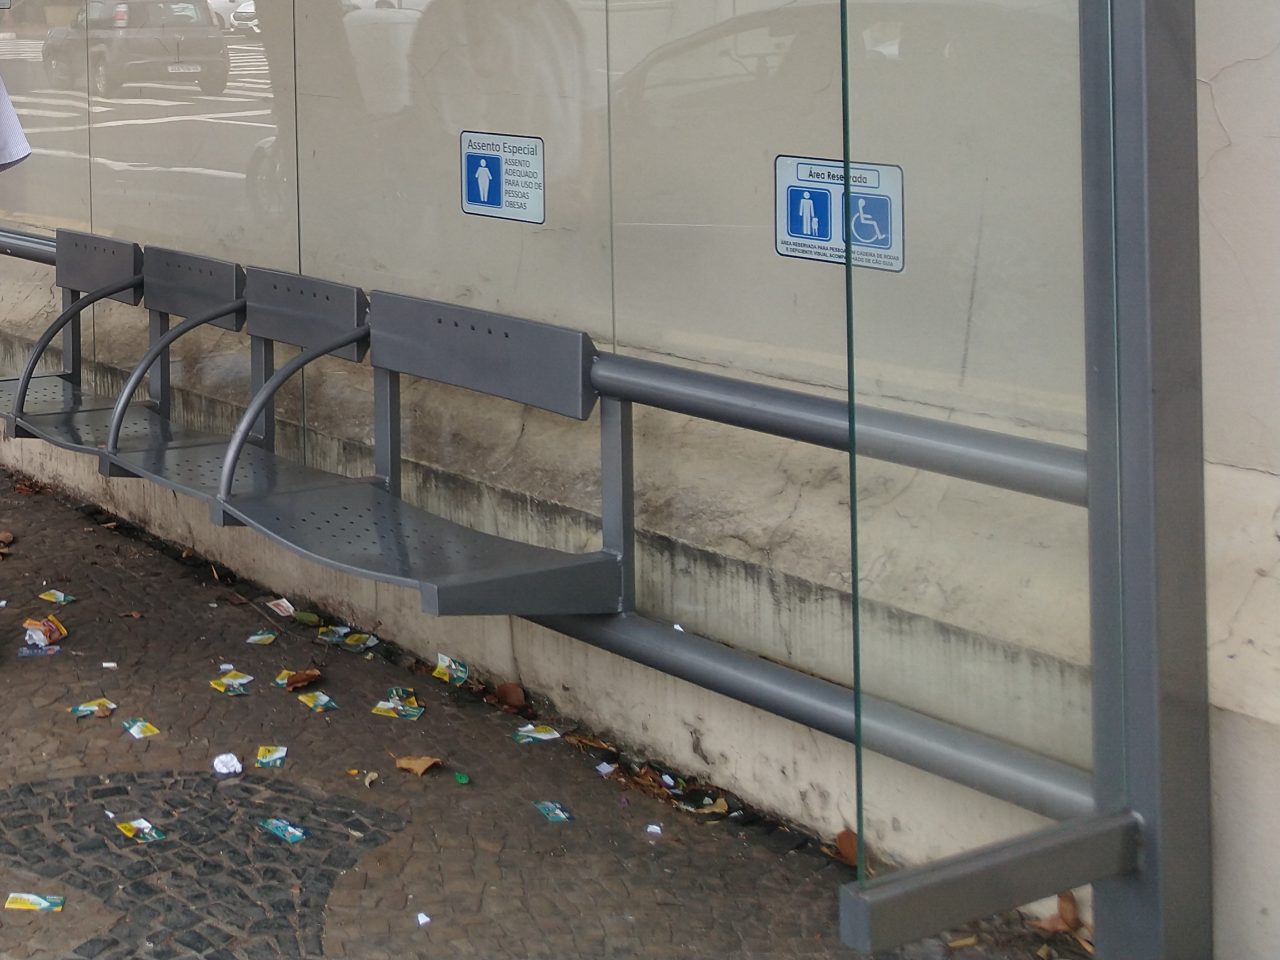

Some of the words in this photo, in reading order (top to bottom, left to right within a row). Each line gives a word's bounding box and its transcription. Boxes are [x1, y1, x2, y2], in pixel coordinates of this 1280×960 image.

[468, 139, 500, 152] Assento
[503, 142, 537, 156] Especial
[504, 158, 530, 167] ASSENTO
[505, 169, 538, 179] ADEQUADO
[808, 167, 825, 179] Área
[828, 171, 868, 184] Reseada
[505, 179, 520, 187] PARA
[505, 190, 529, 199] PESSOAS
[505, 200, 527, 210] OBESAS
